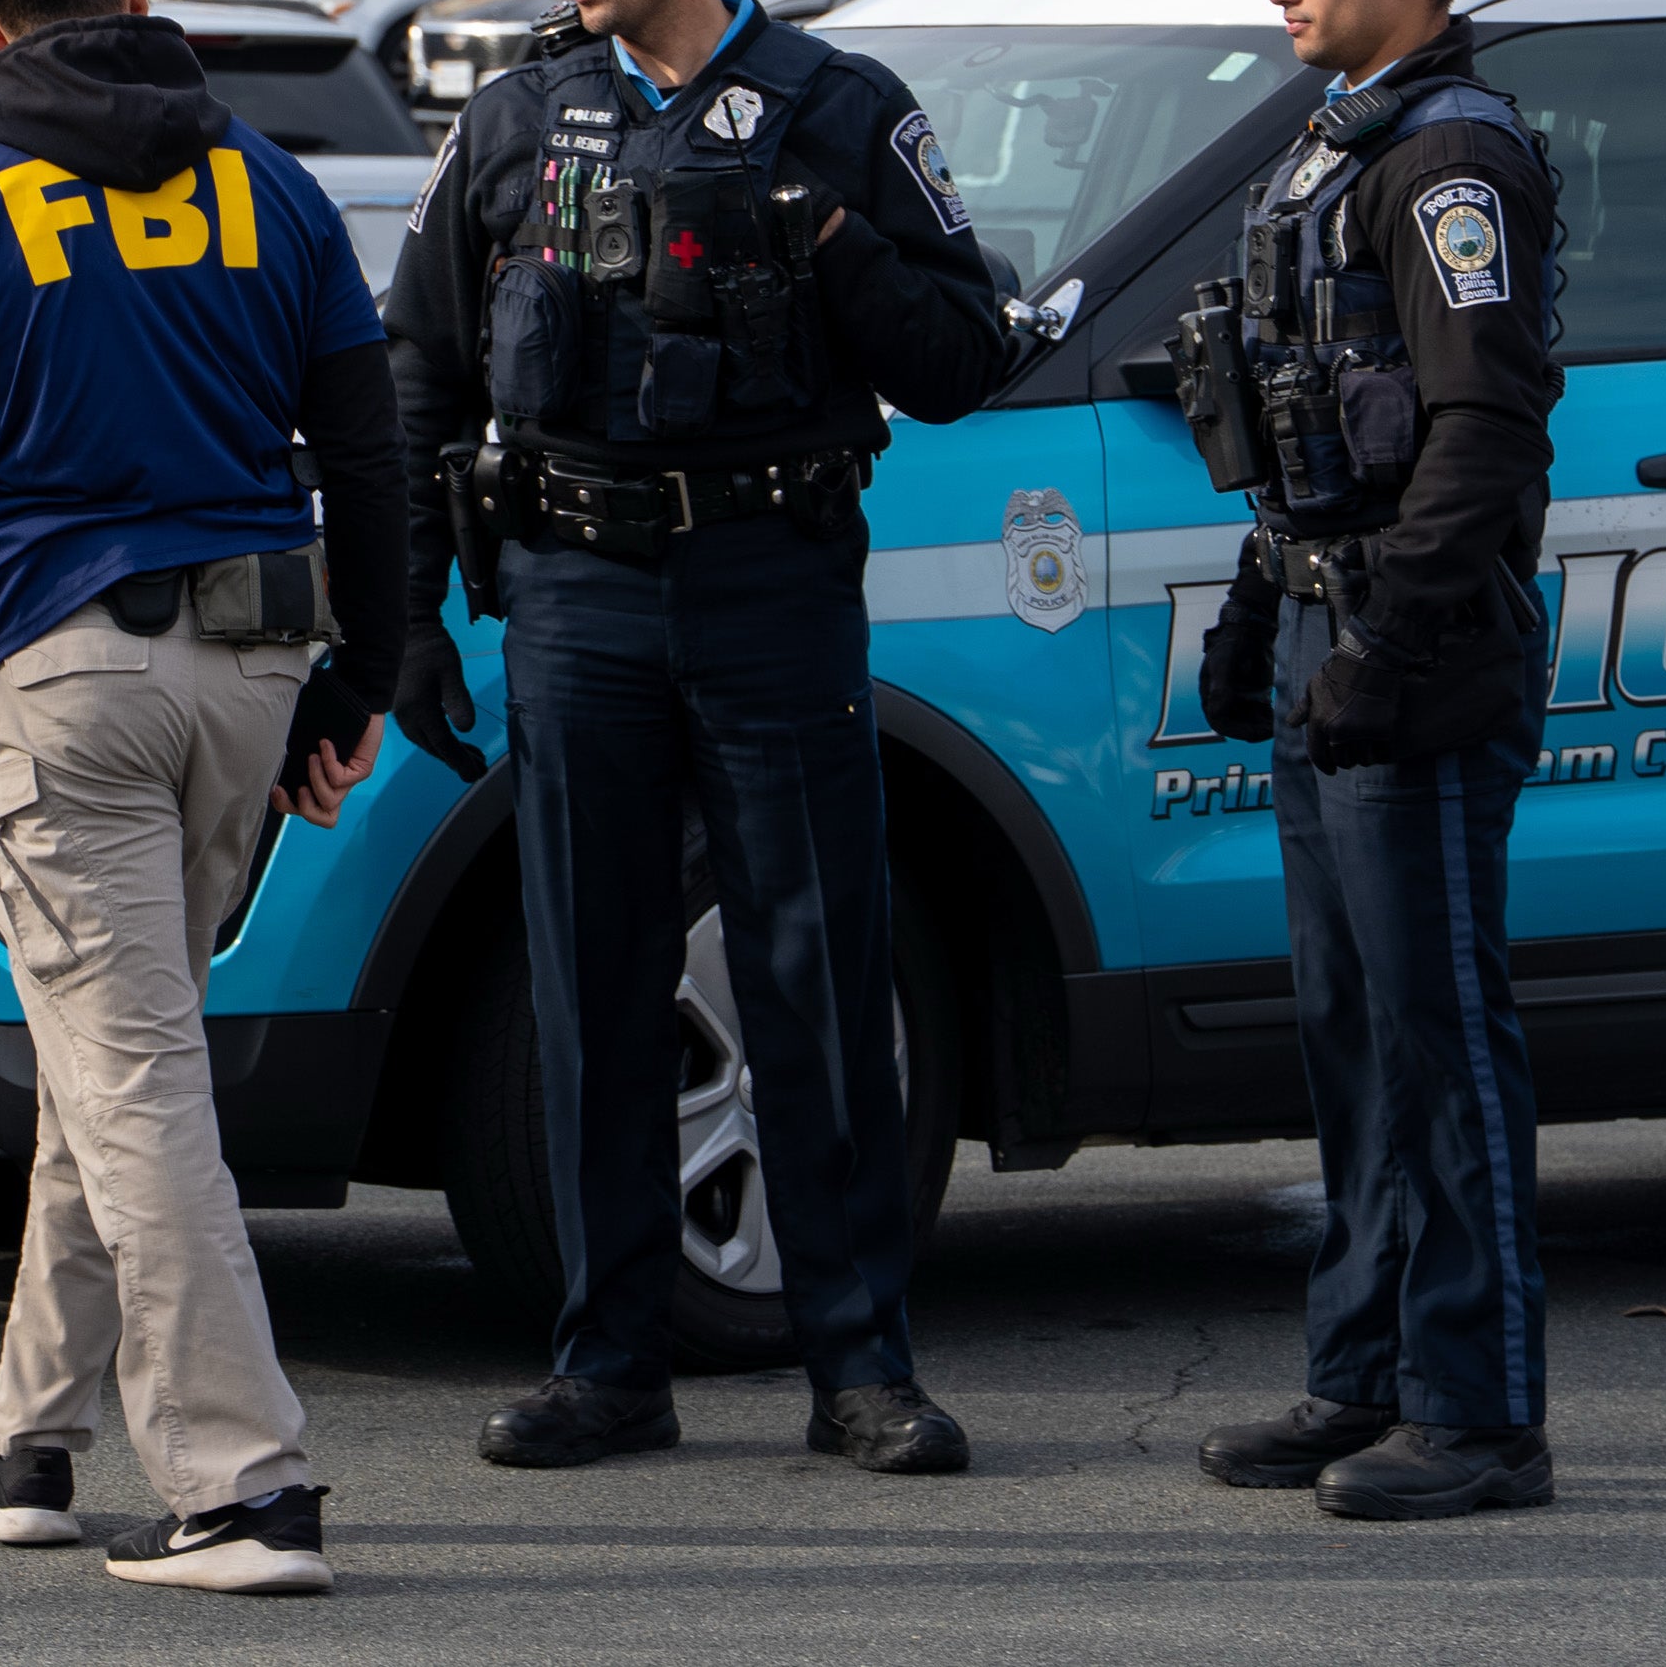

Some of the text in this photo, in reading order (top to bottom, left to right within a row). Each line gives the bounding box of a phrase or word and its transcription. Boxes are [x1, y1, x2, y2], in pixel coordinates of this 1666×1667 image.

[564, 108, 614, 124] POLICE
[1422, 187, 1492, 217] POLICE
[1451, 269, 1492, 283] Prince
[1454, 278, 1497, 292] William
[1459, 287, 1499, 301] County
[1030, 593, 1066, 607] POLICE
[1151, 764, 1273, 820] Prin
